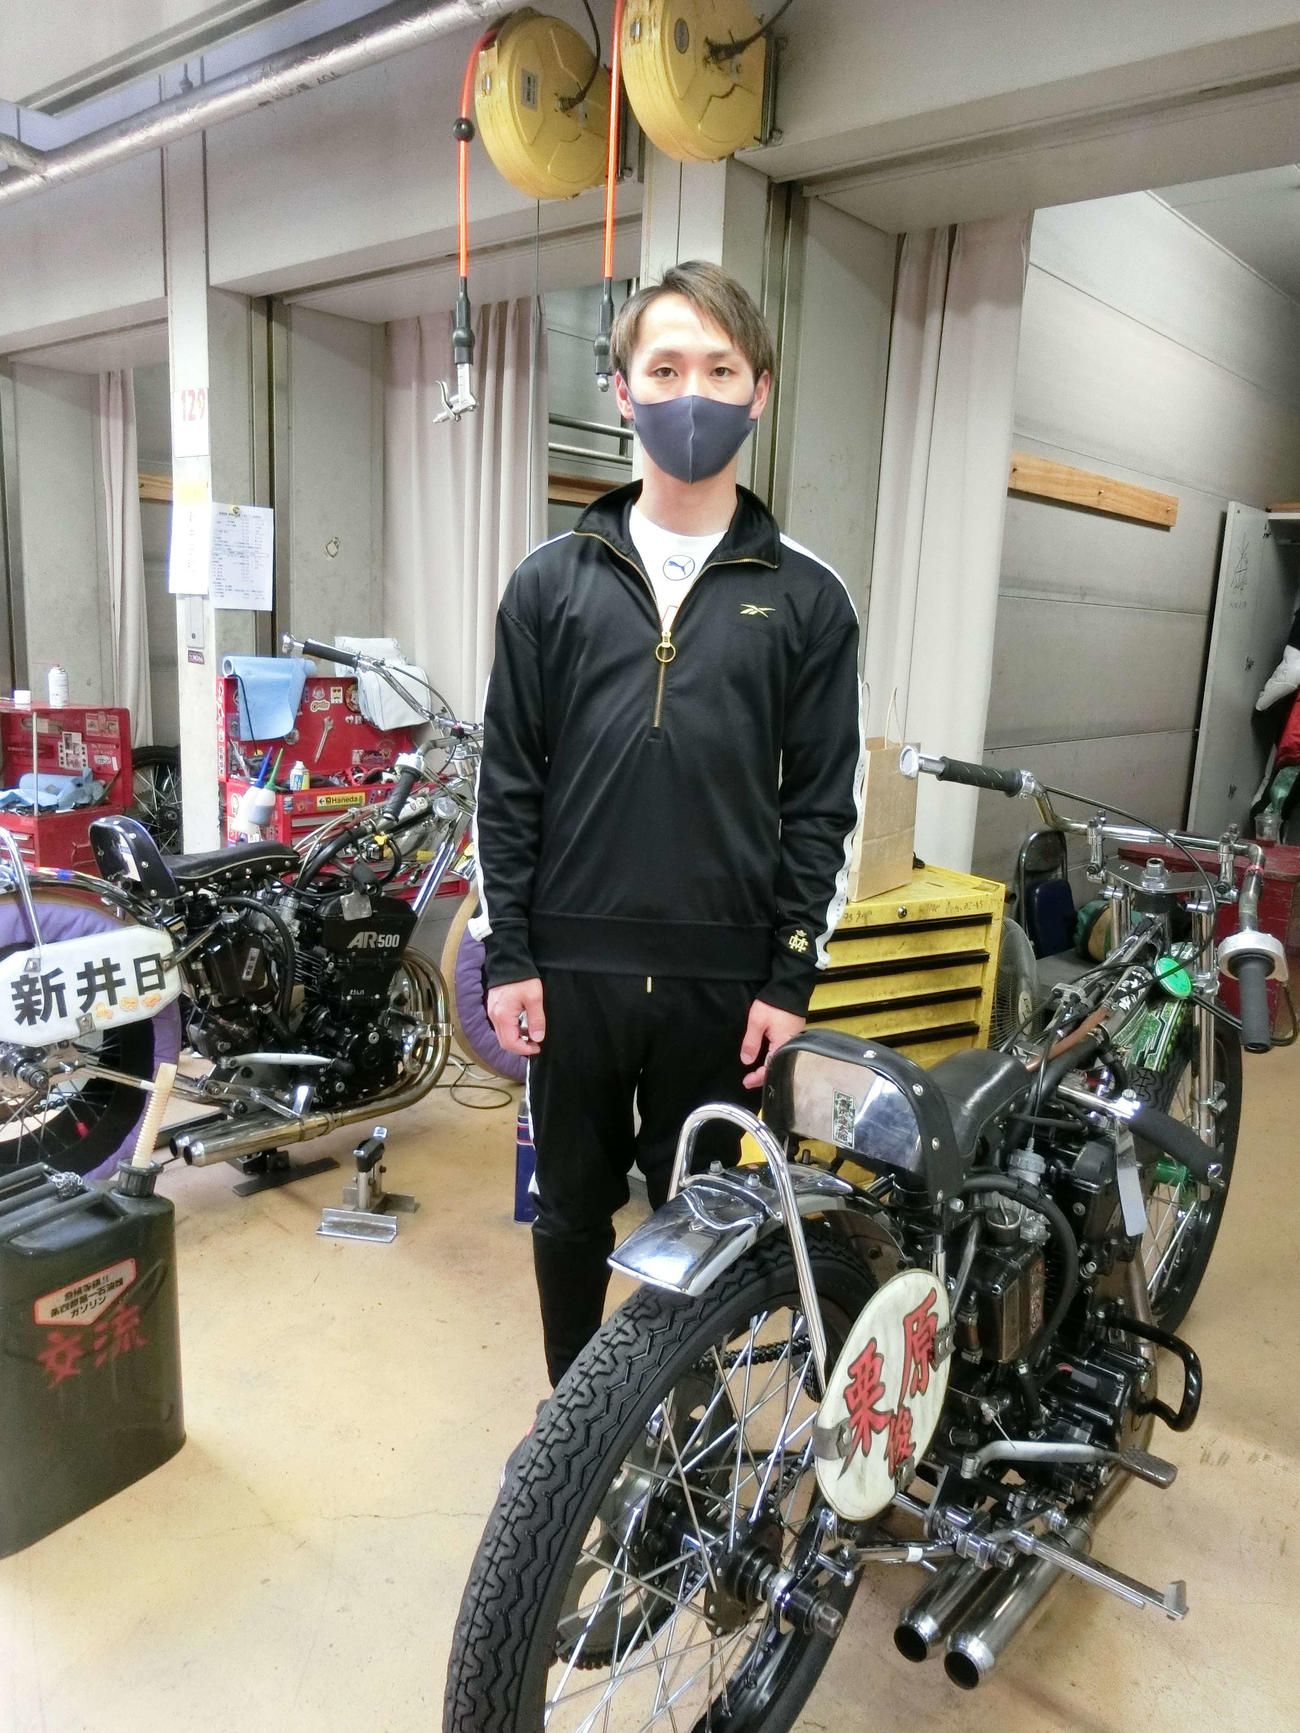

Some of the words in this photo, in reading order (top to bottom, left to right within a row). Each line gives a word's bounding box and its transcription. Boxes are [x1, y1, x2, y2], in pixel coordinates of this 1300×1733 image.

[181, 388, 206, 421] 129
[11, 953, 166, 1026] 新井日
[71, 1296, 107, 1319] ガソリン
